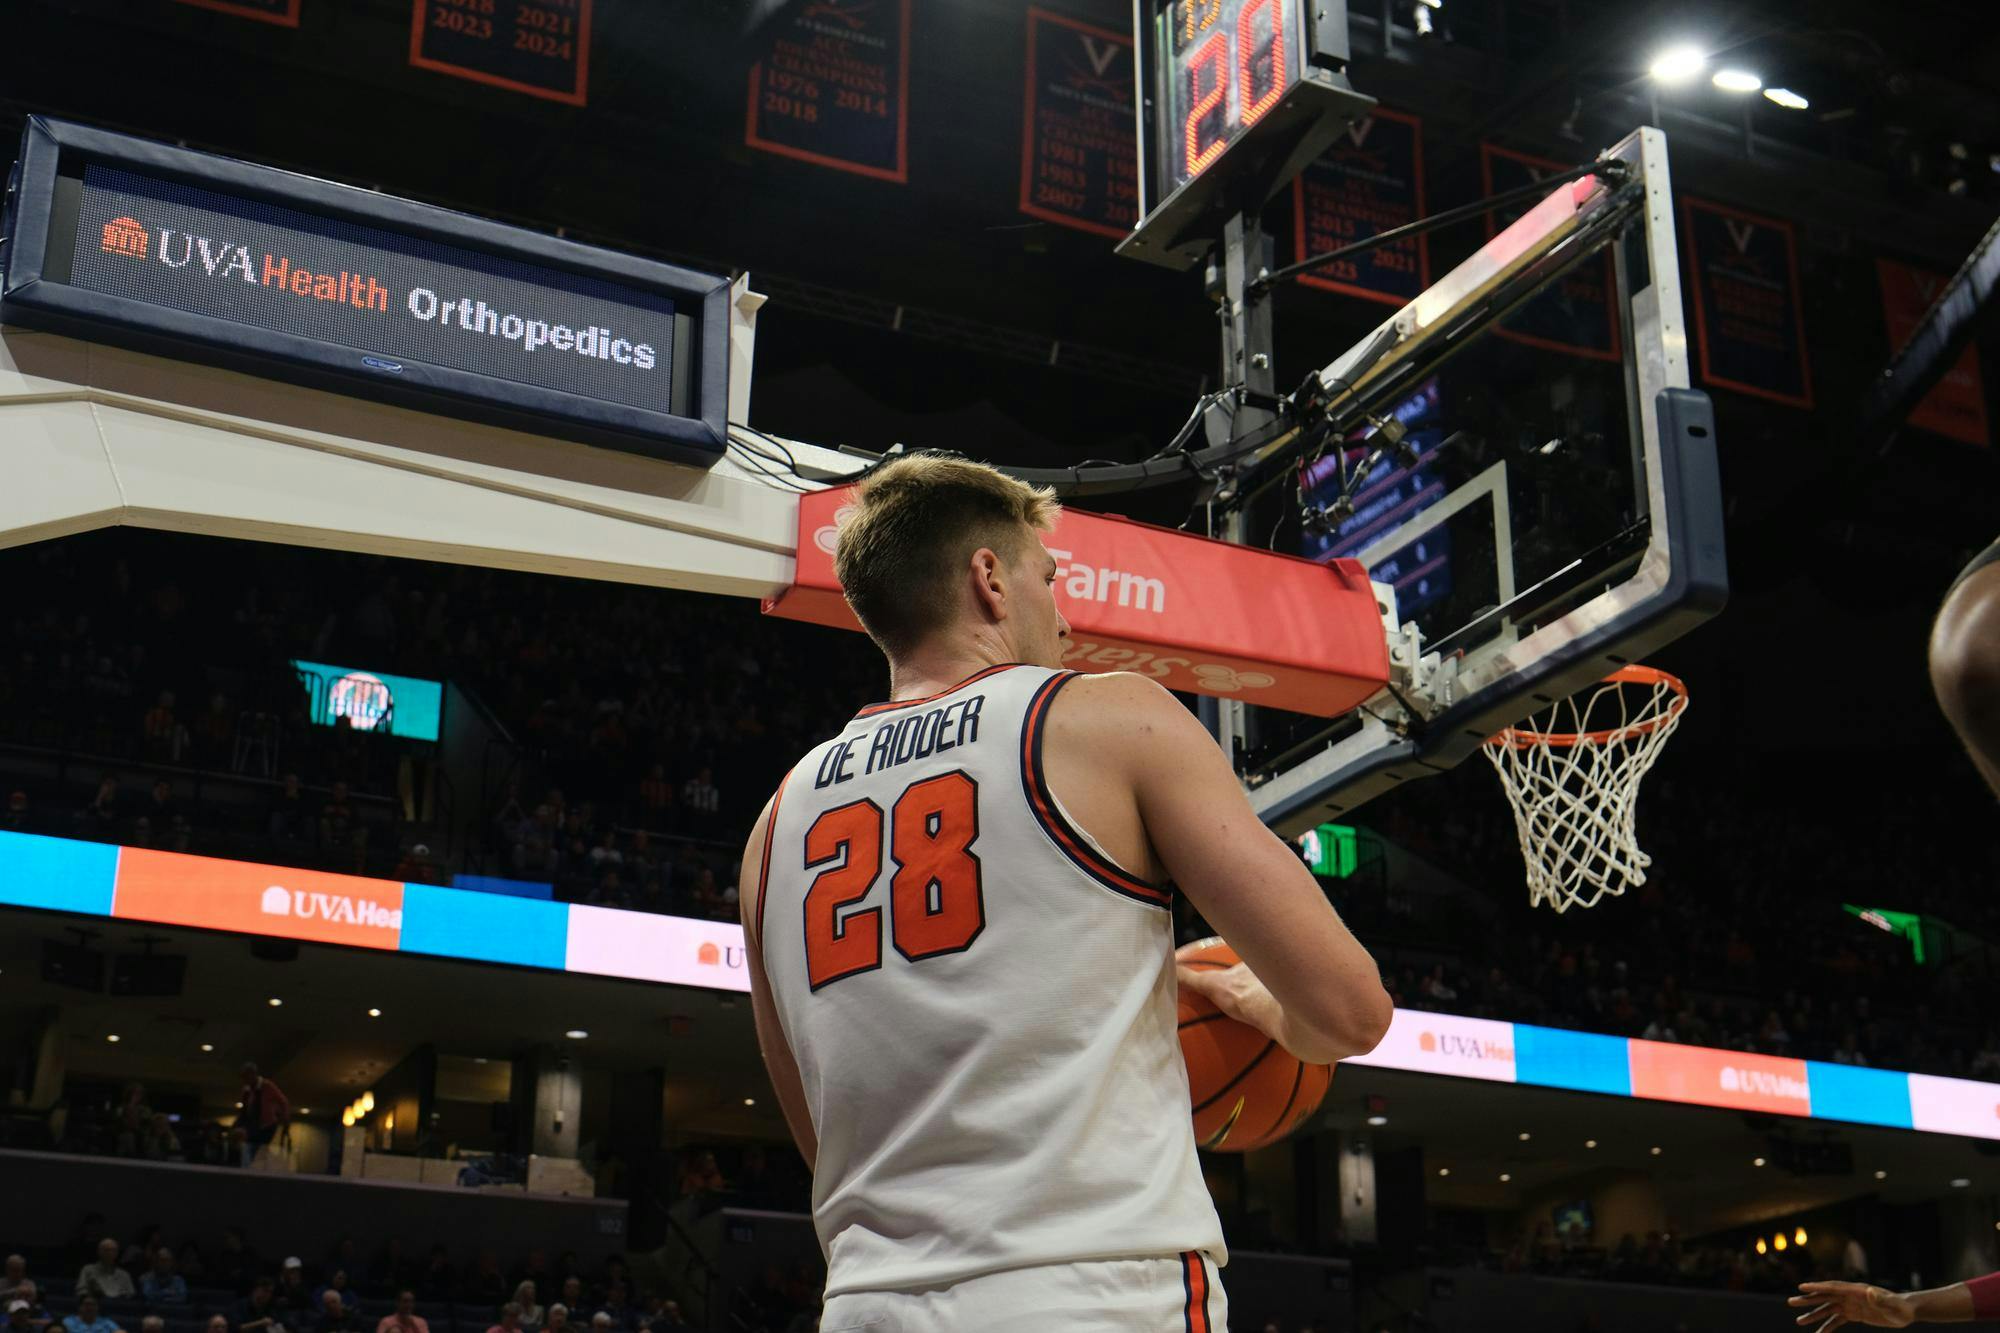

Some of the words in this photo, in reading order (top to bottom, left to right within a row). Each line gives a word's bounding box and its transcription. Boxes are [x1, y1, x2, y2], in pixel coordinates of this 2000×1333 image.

[433, 6, 493, 39] 2023
[515, 4, 571, 35] 2021
[514, 28, 572, 61] 2024
[765, 91, 818, 123] 2018
[767, 68, 819, 99] 1976
[835, 89, 888, 118] 2014
[1186, 0, 1286, 176] 20
[408, 287, 656, 370] Orthopedics
[1047, 547, 1166, 613] Farm
[815, 733, 868, 790] DE
[864, 694, 986, 775] RIDDER
[804, 768, 986, 991] 28
